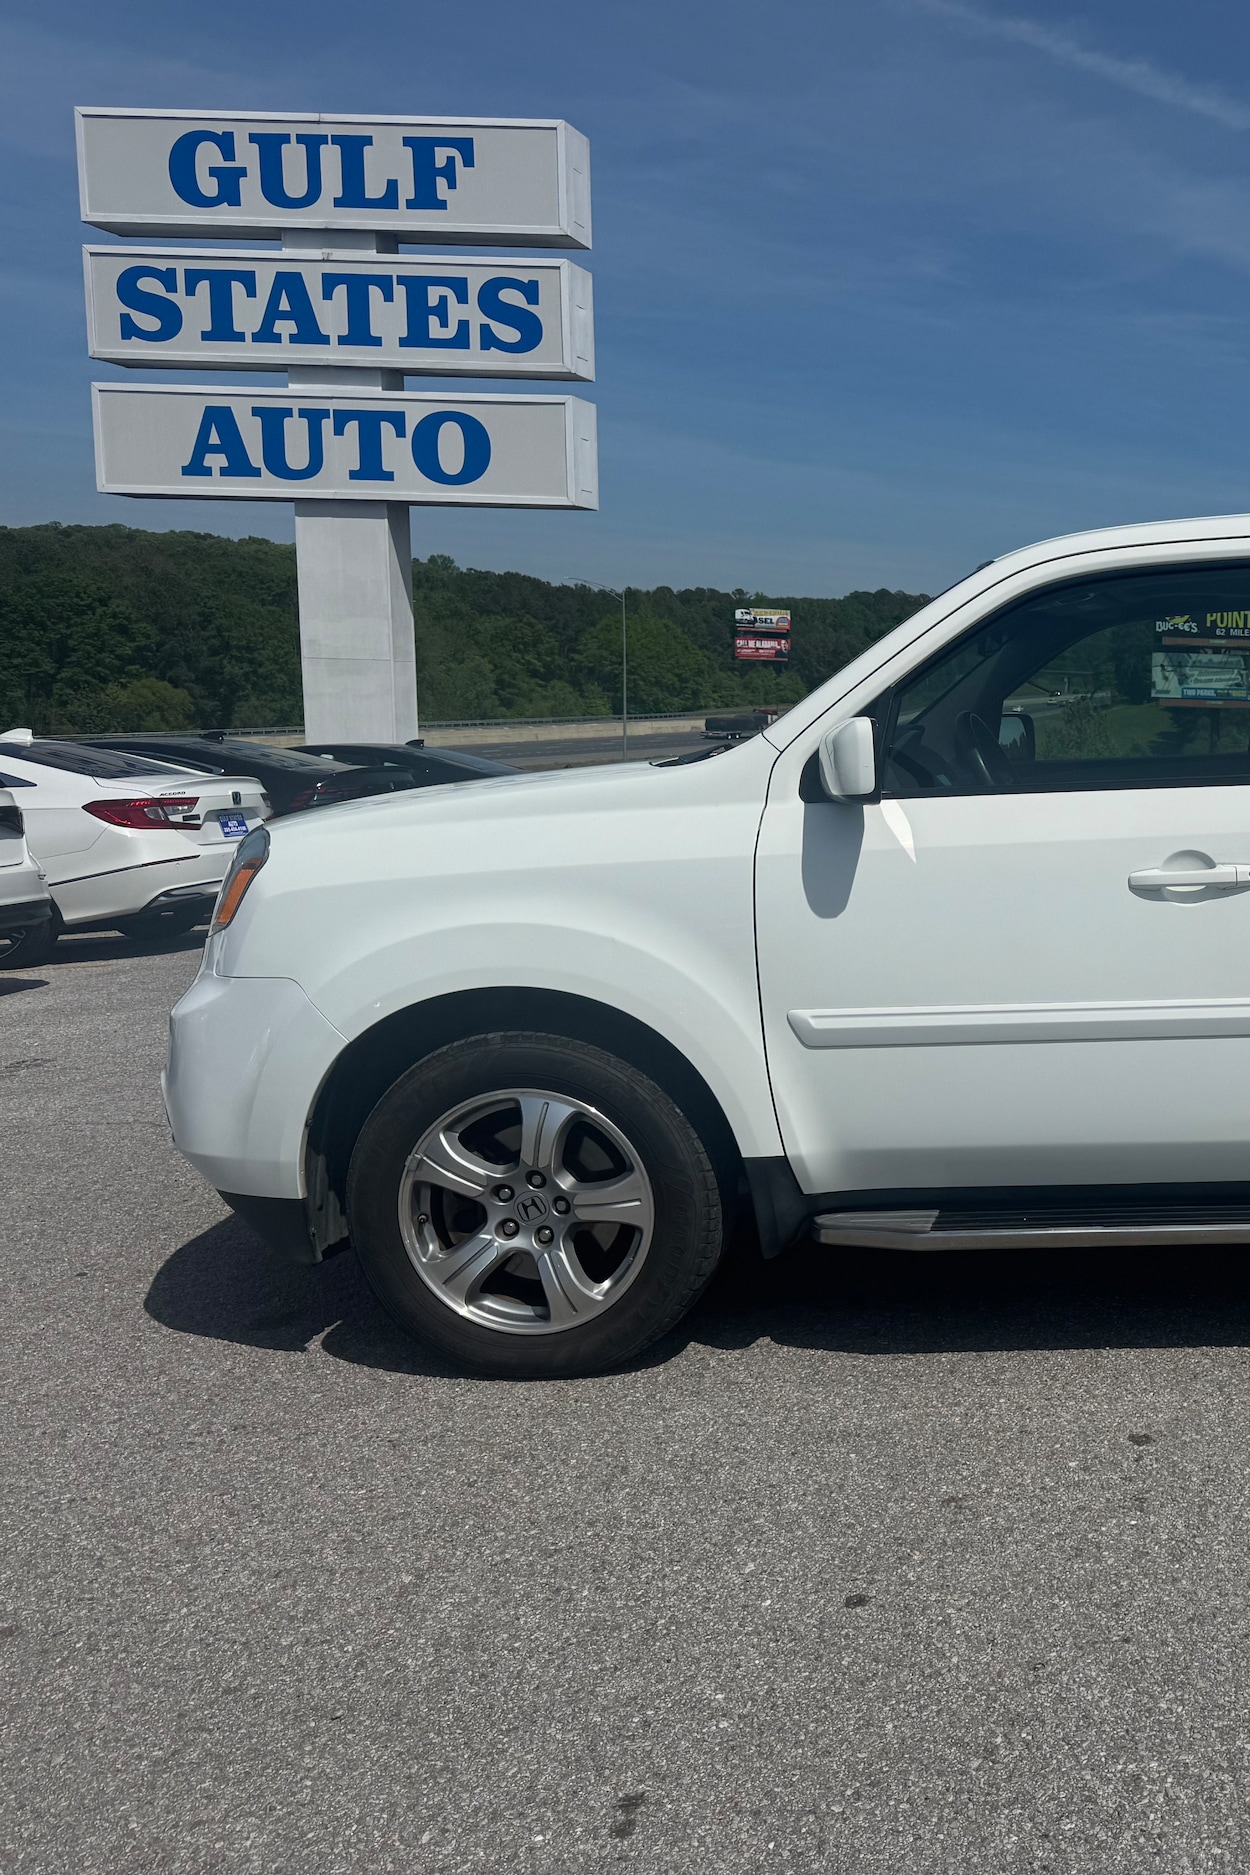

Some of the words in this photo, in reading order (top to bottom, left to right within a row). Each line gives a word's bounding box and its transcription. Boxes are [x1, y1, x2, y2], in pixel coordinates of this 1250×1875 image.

[168, 130, 475, 211] GULF
[116, 265, 544, 354] STATES
[181, 405, 492, 486] AUTO
[1216, 628, 1226, 636] 62
